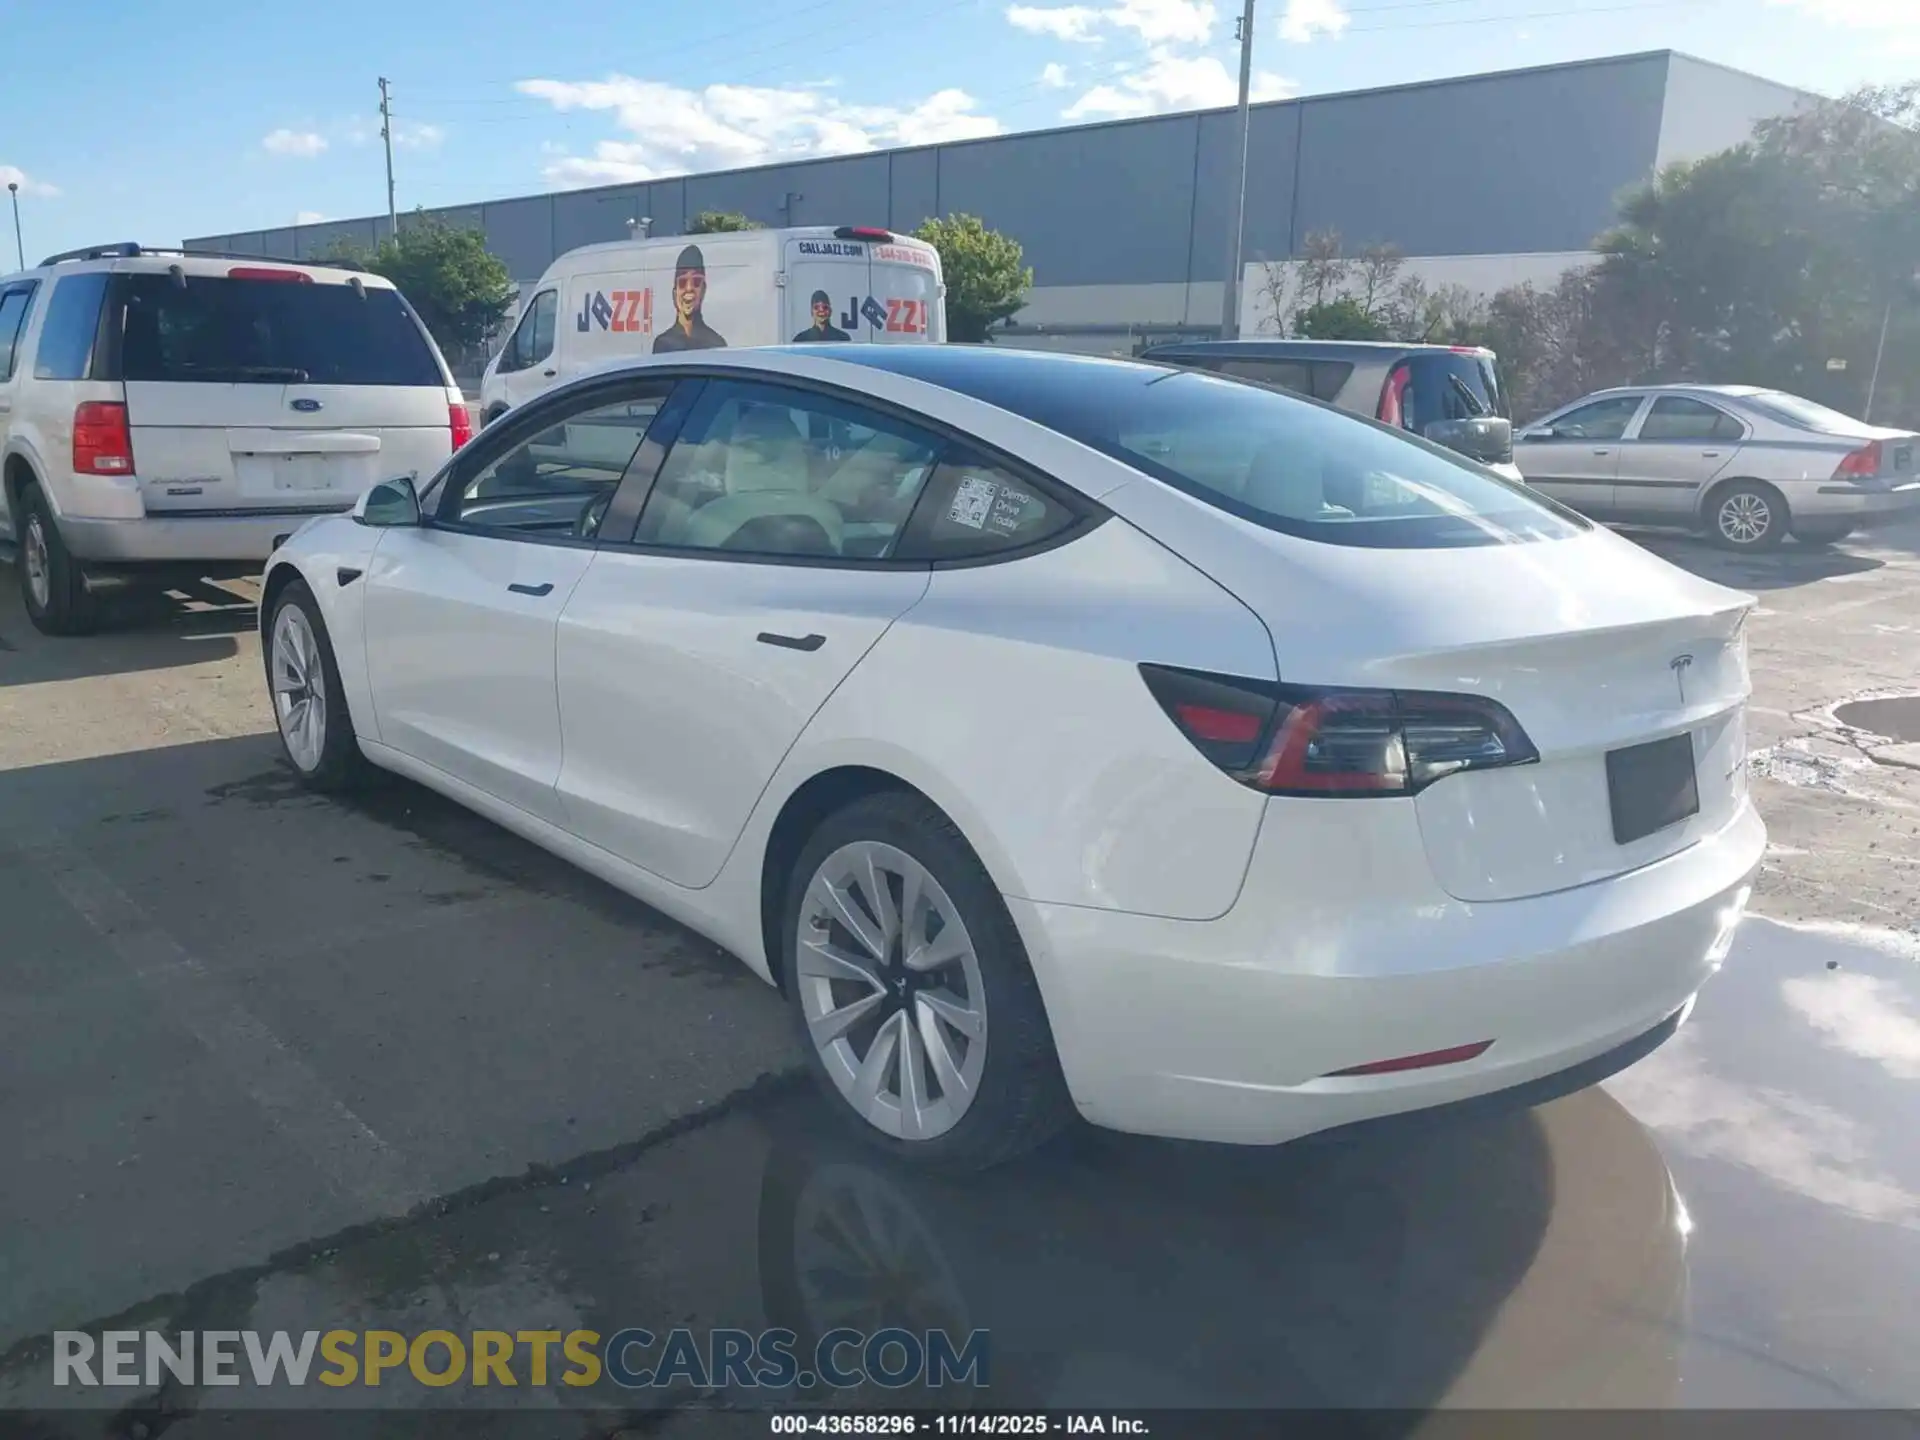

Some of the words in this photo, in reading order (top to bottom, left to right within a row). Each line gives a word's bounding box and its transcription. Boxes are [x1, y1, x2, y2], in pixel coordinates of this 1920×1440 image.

[799, 242, 863, 257] CALLJAZZ.COM
[577, 287, 653, 333] JAZZ!
[841, 296, 927, 334] JAZZ!
